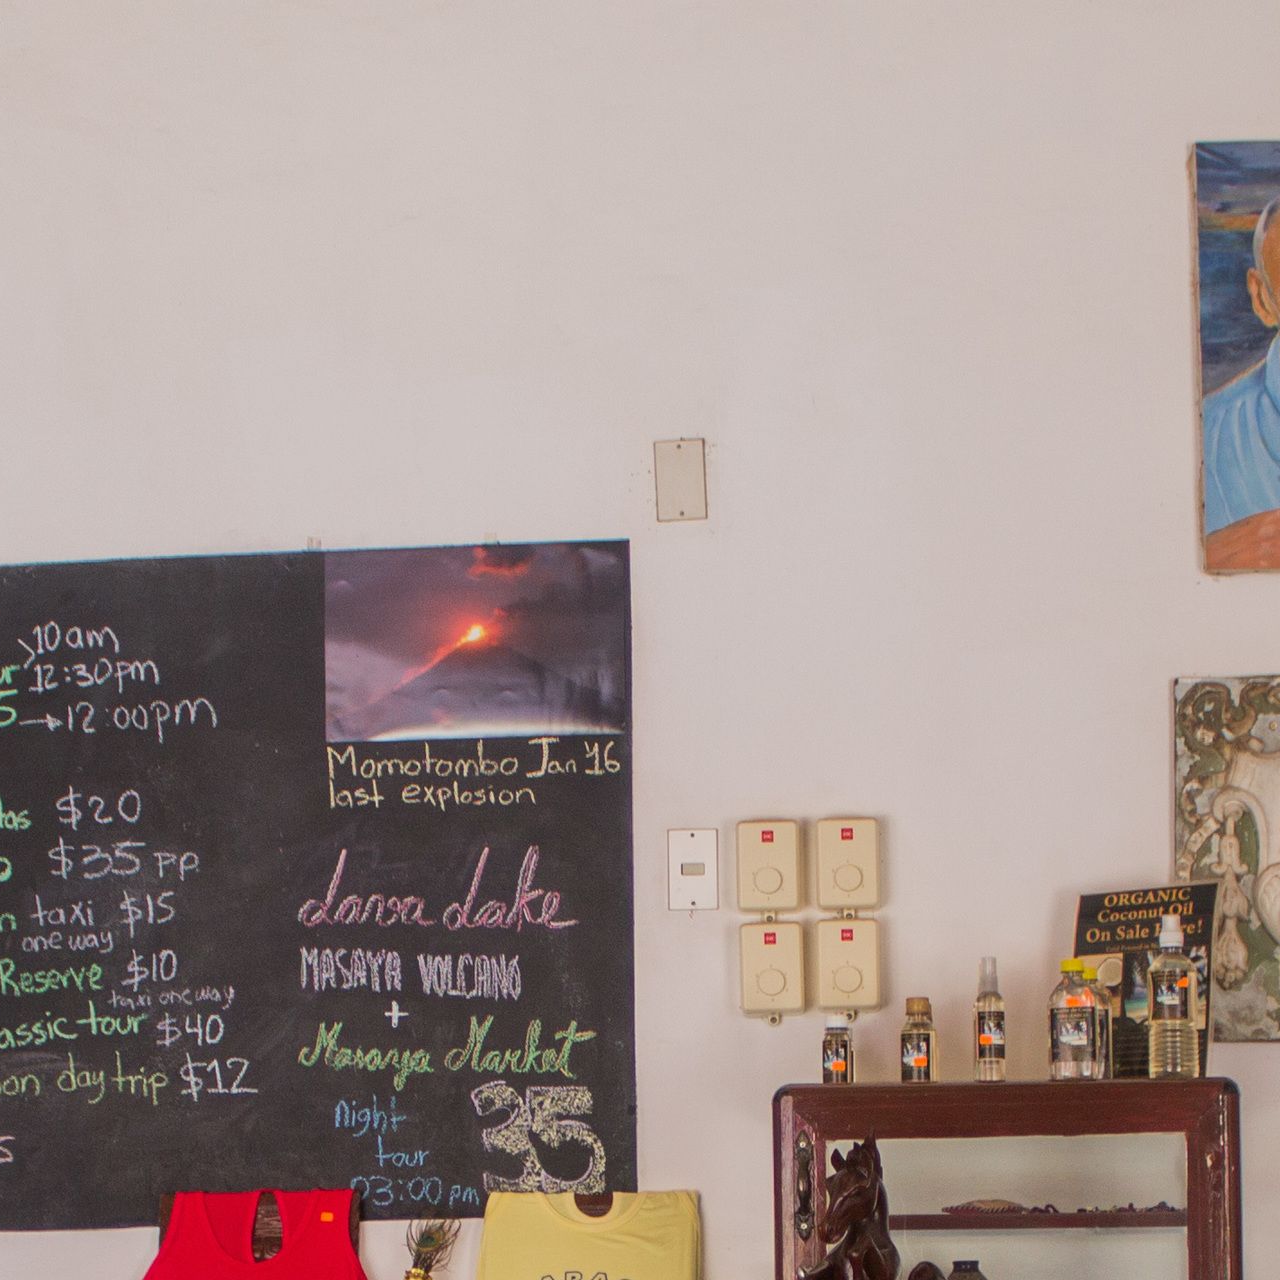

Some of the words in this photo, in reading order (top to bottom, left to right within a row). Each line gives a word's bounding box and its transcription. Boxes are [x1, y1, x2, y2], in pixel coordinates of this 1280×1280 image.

[28, 657, 160, 695] 12:30pm
[67, 697, 217, 744] 12:00pm
[326, 739, 519, 780] Momotombo
[526, 736, 578, 779] Jan
[55, 785, 142, 831] $20
[329, 780, 385, 809] last
[401, 781, 537, 812] explosion
[47, 837, 147, 880] $35
[30, 894, 94, 927] taxi
[120, 890, 175, 939] $15
[1097, 906, 1165, 924] Coconut
[1168, 901, 1194, 918] Oil
[1104, 887, 1192, 908] ORGANIC
[22, 931, 63, 953] one
[67, 930, 114, 954] way
[1086, 926, 1111, 943] On
[1116, 922, 1150, 941] Sale
[121, 949, 178, 992] $10
[300, 946, 403, 993] MASAYA
[416, 953, 522, 1000] VOLCANO
[76, 1000, 147, 1036] tour
[107, 990, 152, 1011] taxi
[156, 1012, 224, 1047] $40
[297, 1021, 435, 1092] Masaya
[444, 1014, 598, 1080] Market
[57, 1053, 106, 1104] day
[111, 1050, 169, 1105] trip
[180, 1053, 259, 1101] $12
[375, 1134, 430, 1168] tour
